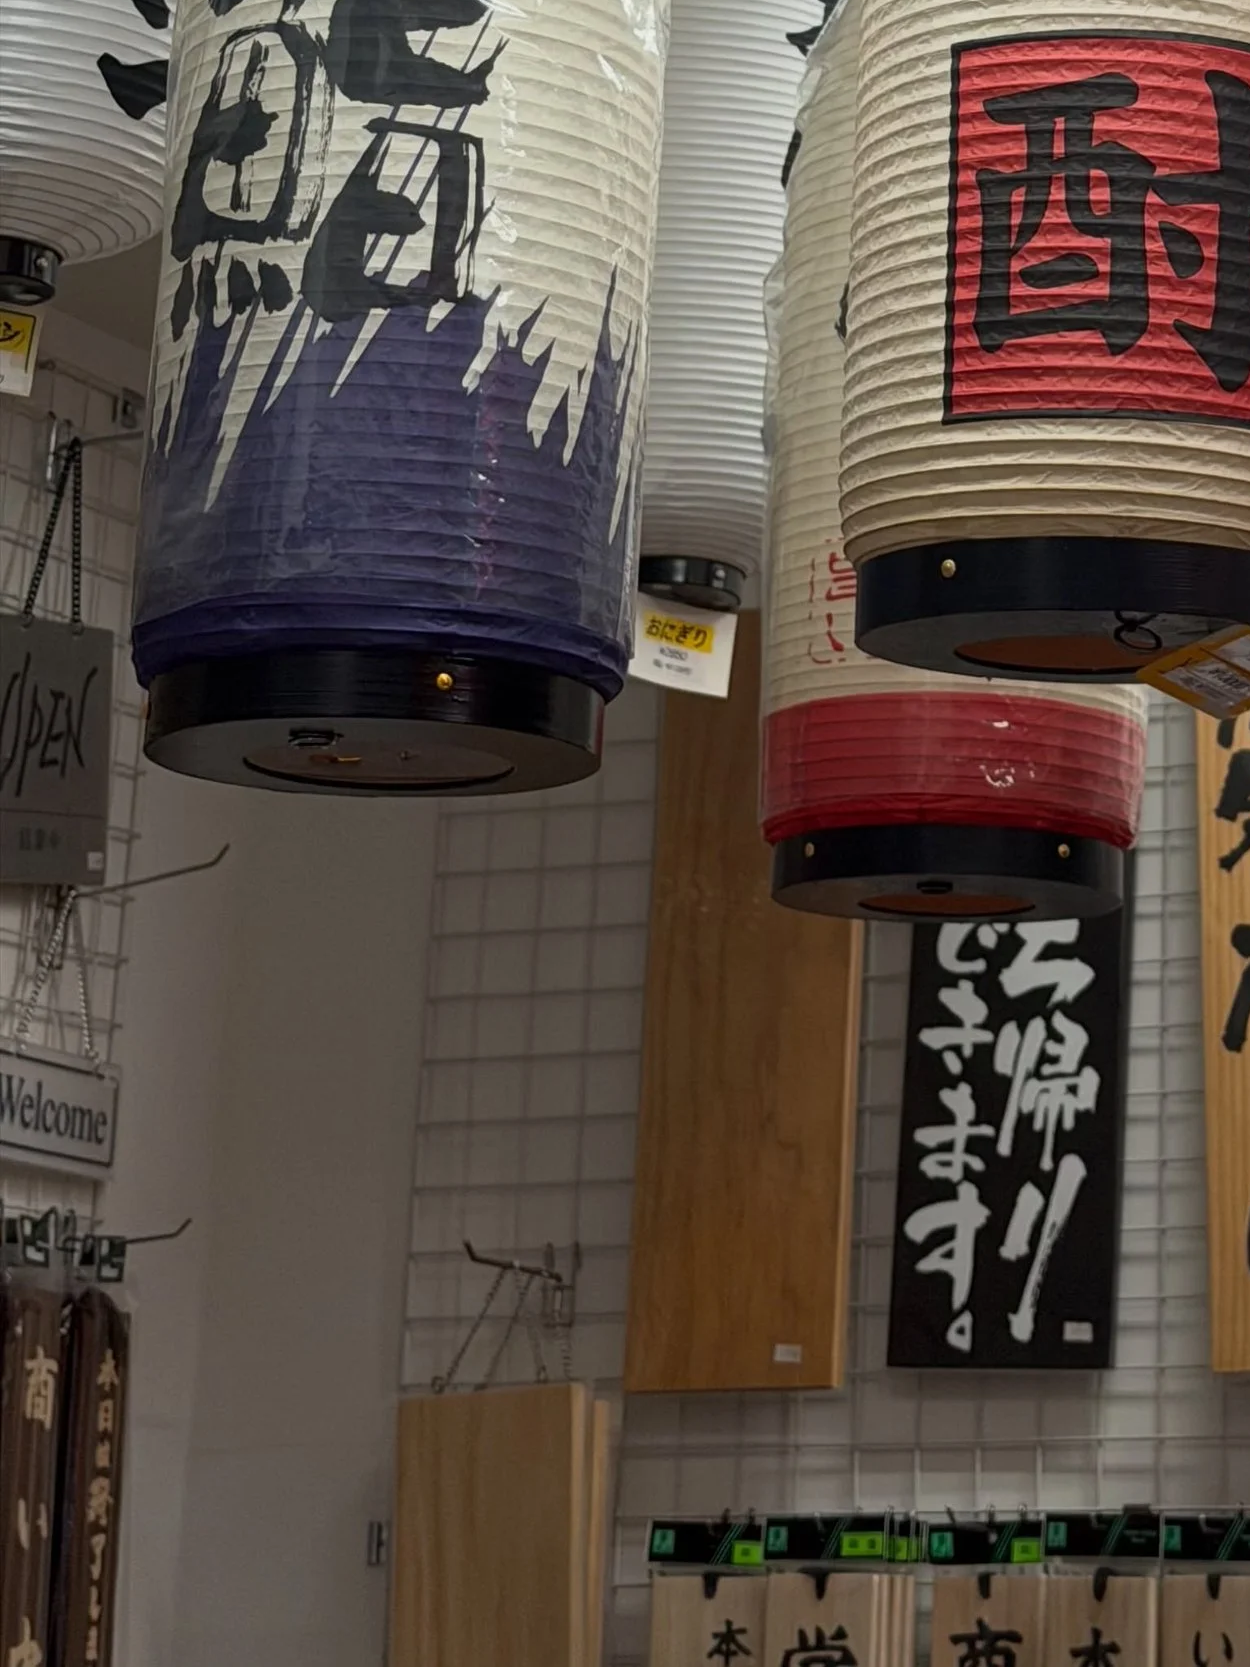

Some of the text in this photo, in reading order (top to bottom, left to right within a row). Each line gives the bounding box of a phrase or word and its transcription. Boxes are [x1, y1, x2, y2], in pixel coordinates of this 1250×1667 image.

[646, 615, 708, 649] おにぎり
[0, 1072, 108, 1145] Welcome
